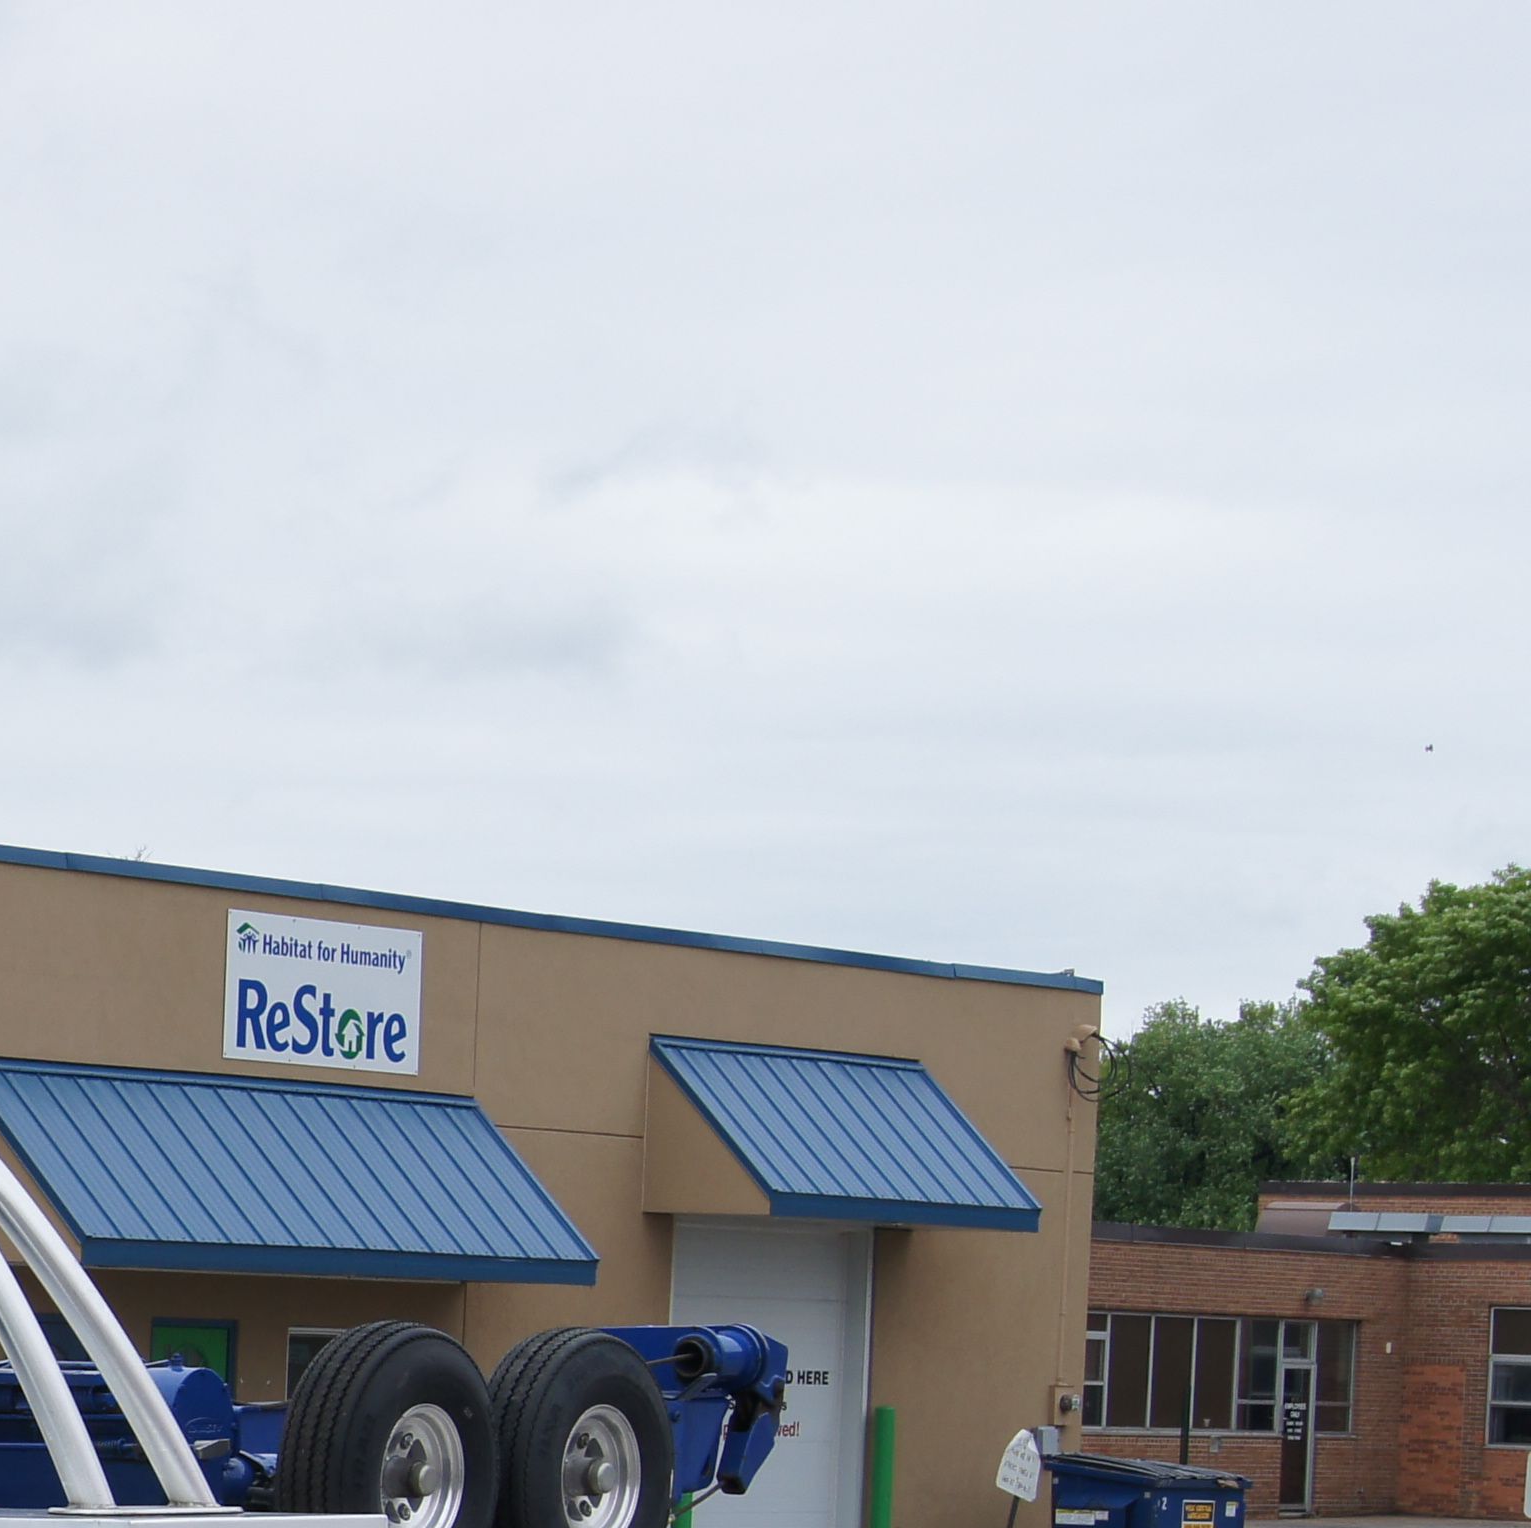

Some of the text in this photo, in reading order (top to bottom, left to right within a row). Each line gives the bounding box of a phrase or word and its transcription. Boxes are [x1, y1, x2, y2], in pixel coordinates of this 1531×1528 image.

[262, 933, 406, 974] Habitat for Humanity
[236, 978, 407, 1063] ReStore
[797, 1371, 829, 1385] HERE
